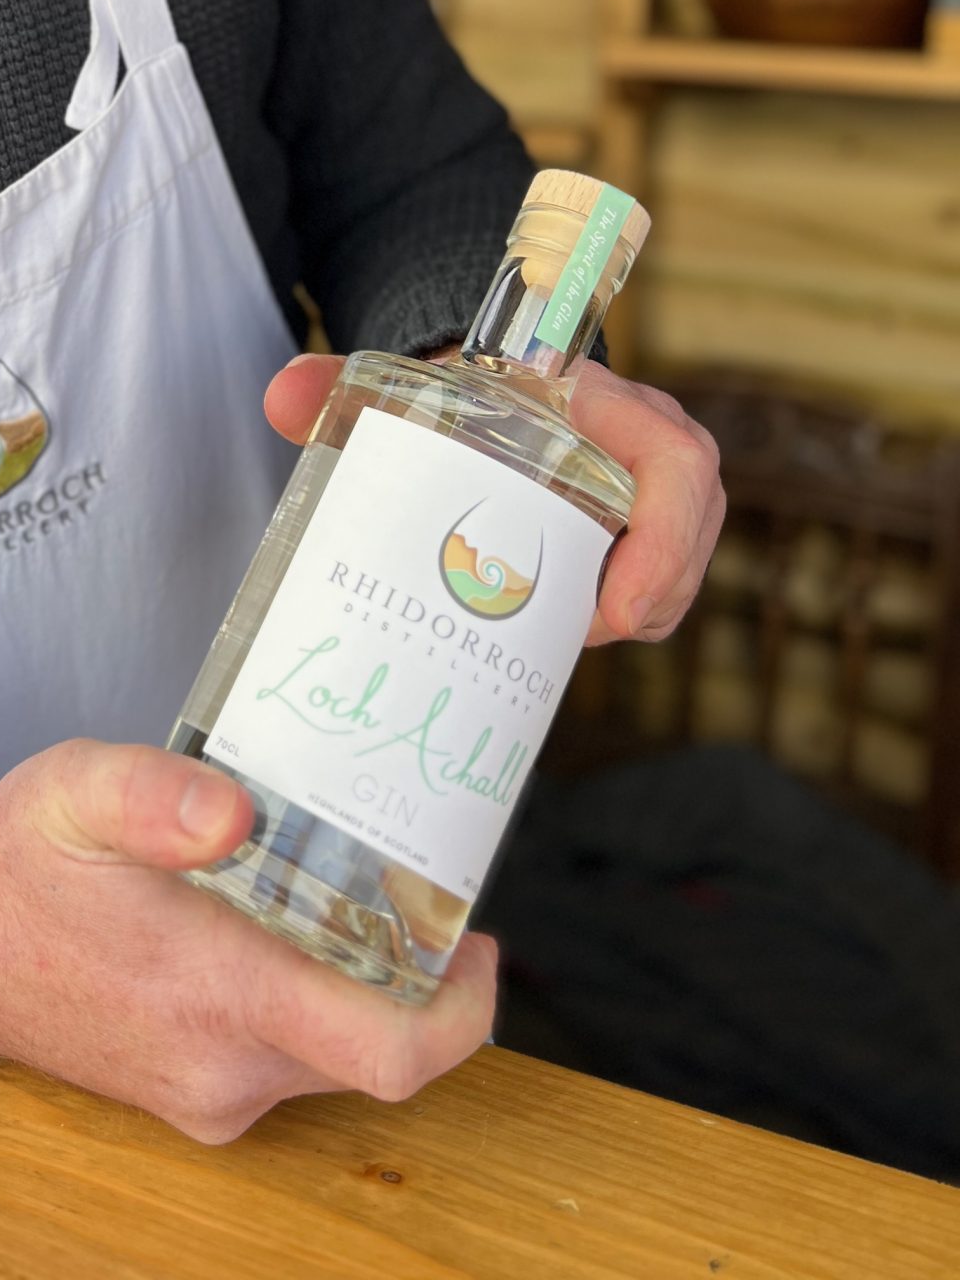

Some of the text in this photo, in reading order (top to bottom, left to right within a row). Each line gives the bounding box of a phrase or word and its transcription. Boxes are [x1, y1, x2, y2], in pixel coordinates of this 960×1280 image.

[552, 207, 617, 331] The Spirit of the Glen
[328, 560, 555, 705] RHIDORROCH
[343, 602, 531, 715] DISTILLERY
[215, 736, 240, 757] 70CL
[256, 636, 529, 808] Loch Achall
[307, 792, 429, 866] HIGHLANDS OF SCOTLAND
[351, 773, 420, 828] GIN
